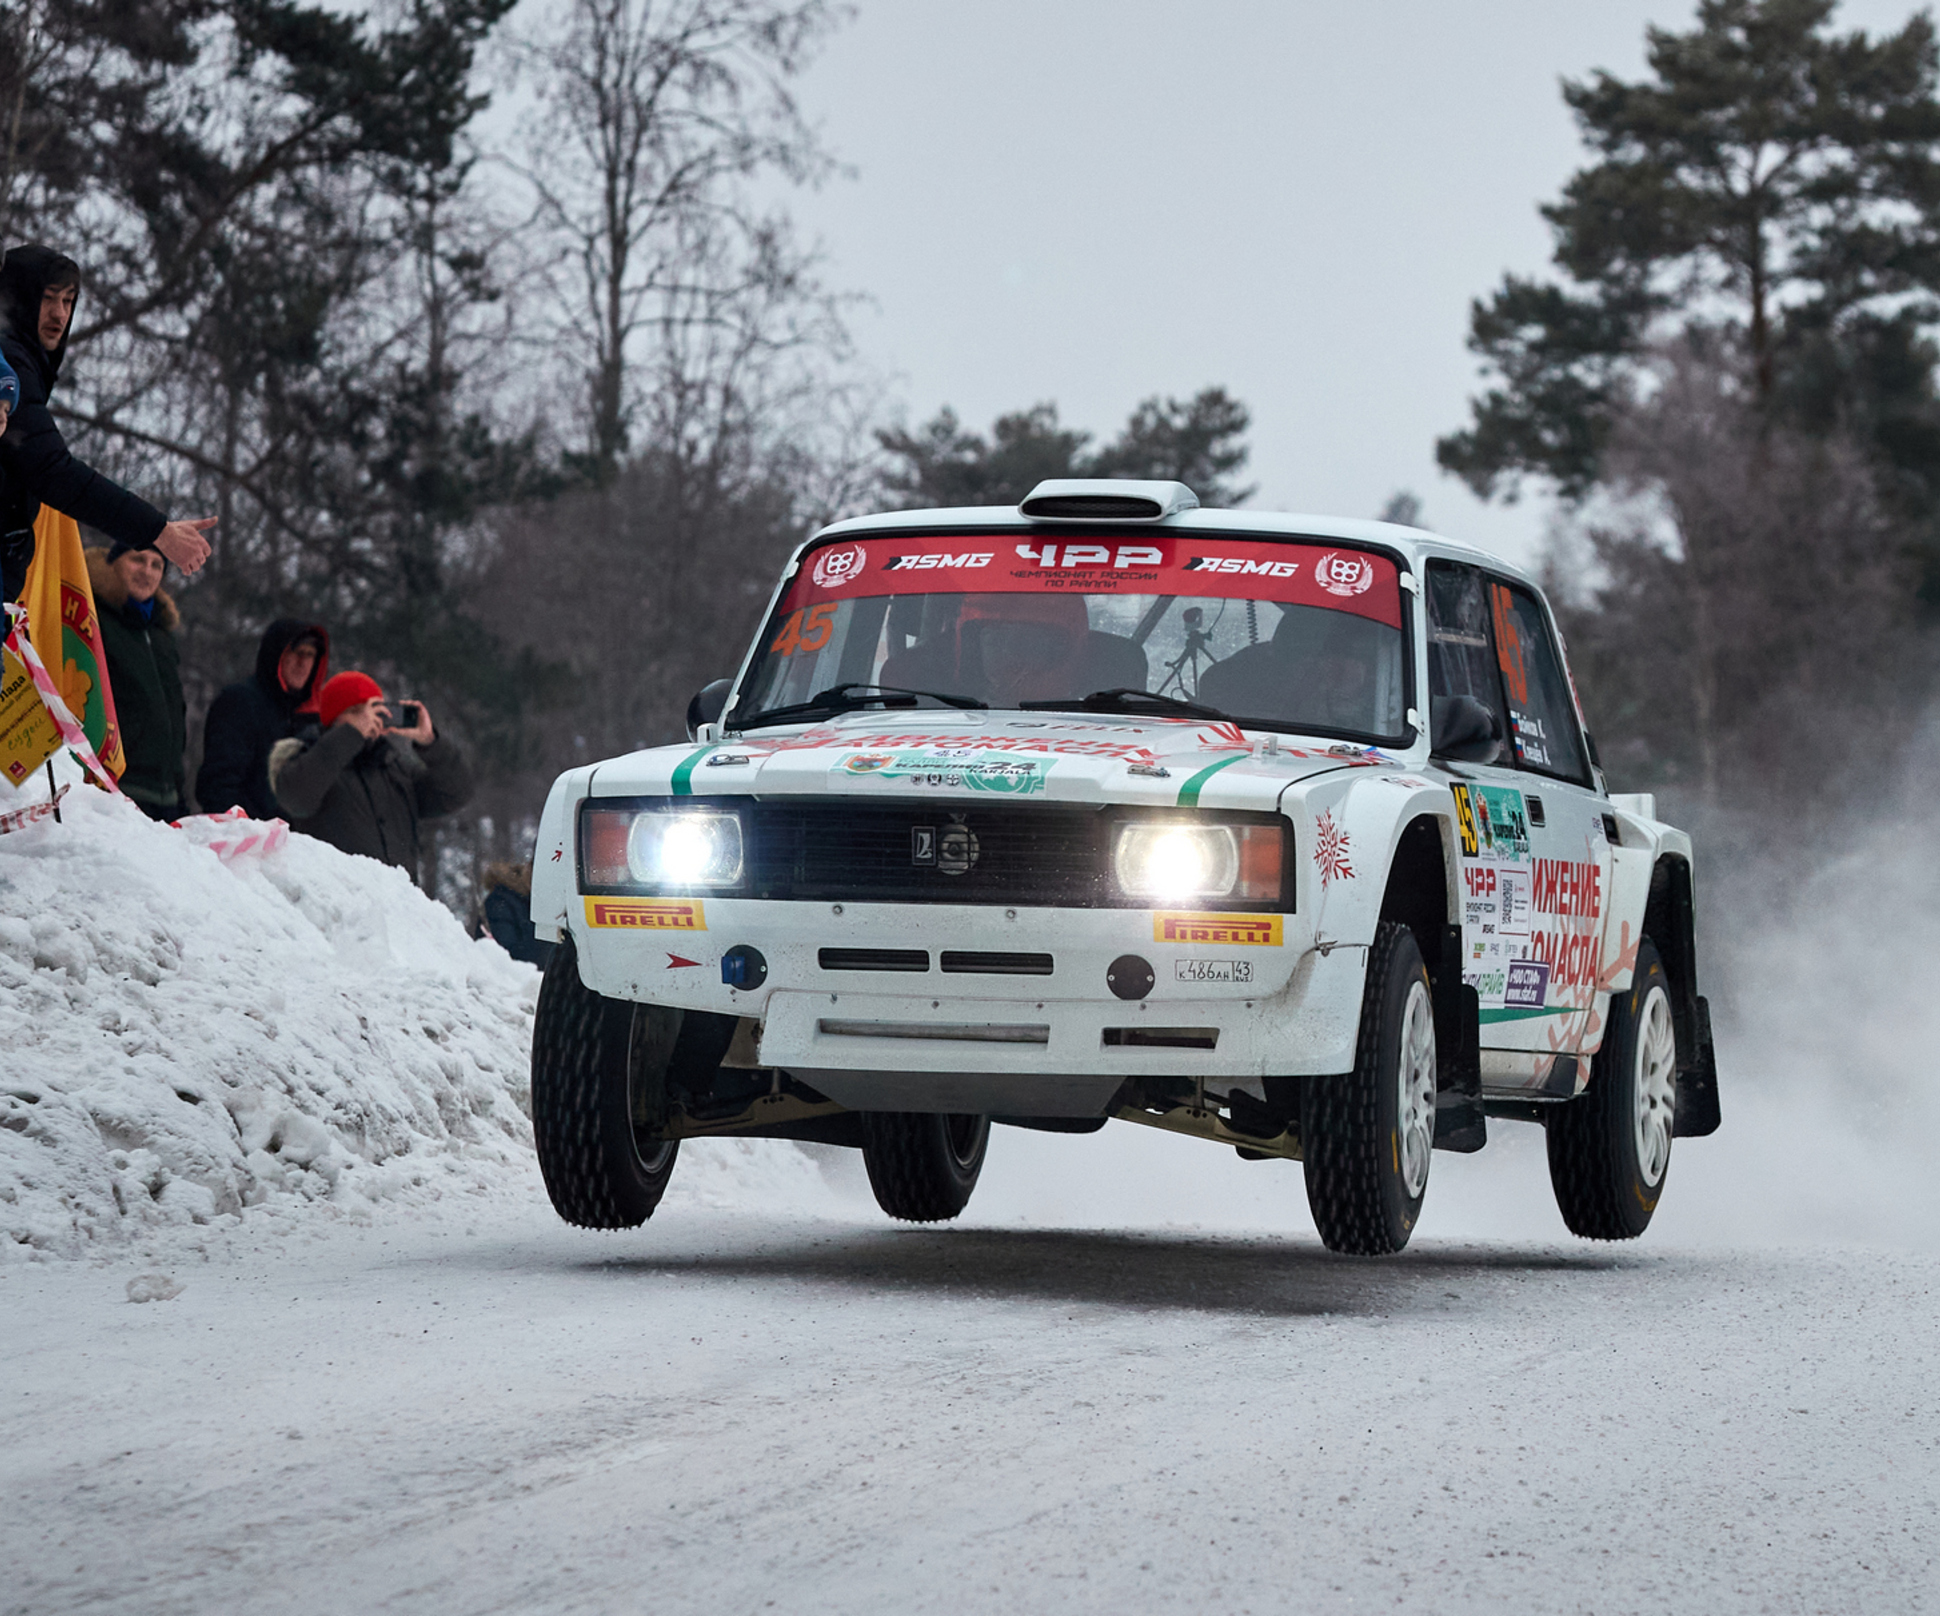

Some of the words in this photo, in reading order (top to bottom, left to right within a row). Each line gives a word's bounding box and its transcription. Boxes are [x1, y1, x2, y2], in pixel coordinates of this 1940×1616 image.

[892, 553, 994, 571] ASMG
[1016, 545, 1163, 568] ЧРР
[1193, 557, 1299, 577] ASMG
[1010, 571, 1095, 579] ЧЕМПИОНАТ
[1100, 571, 1158, 580] РОССИИ
[1045, 580, 1064, 588] ПО
[771, 603, 839, 657] 45
[1492, 583, 1527, 705] 45
[1454, 786, 1477, 853] 45
[1465, 867, 1496, 897] ЧРР
[594, 904, 694, 927] PIRELLI
[1164, 919, 1272, 943] PIRELLI
[1235, 961, 1251, 976] 43
[1531, 930, 1598, 987] ОМАСЛА
